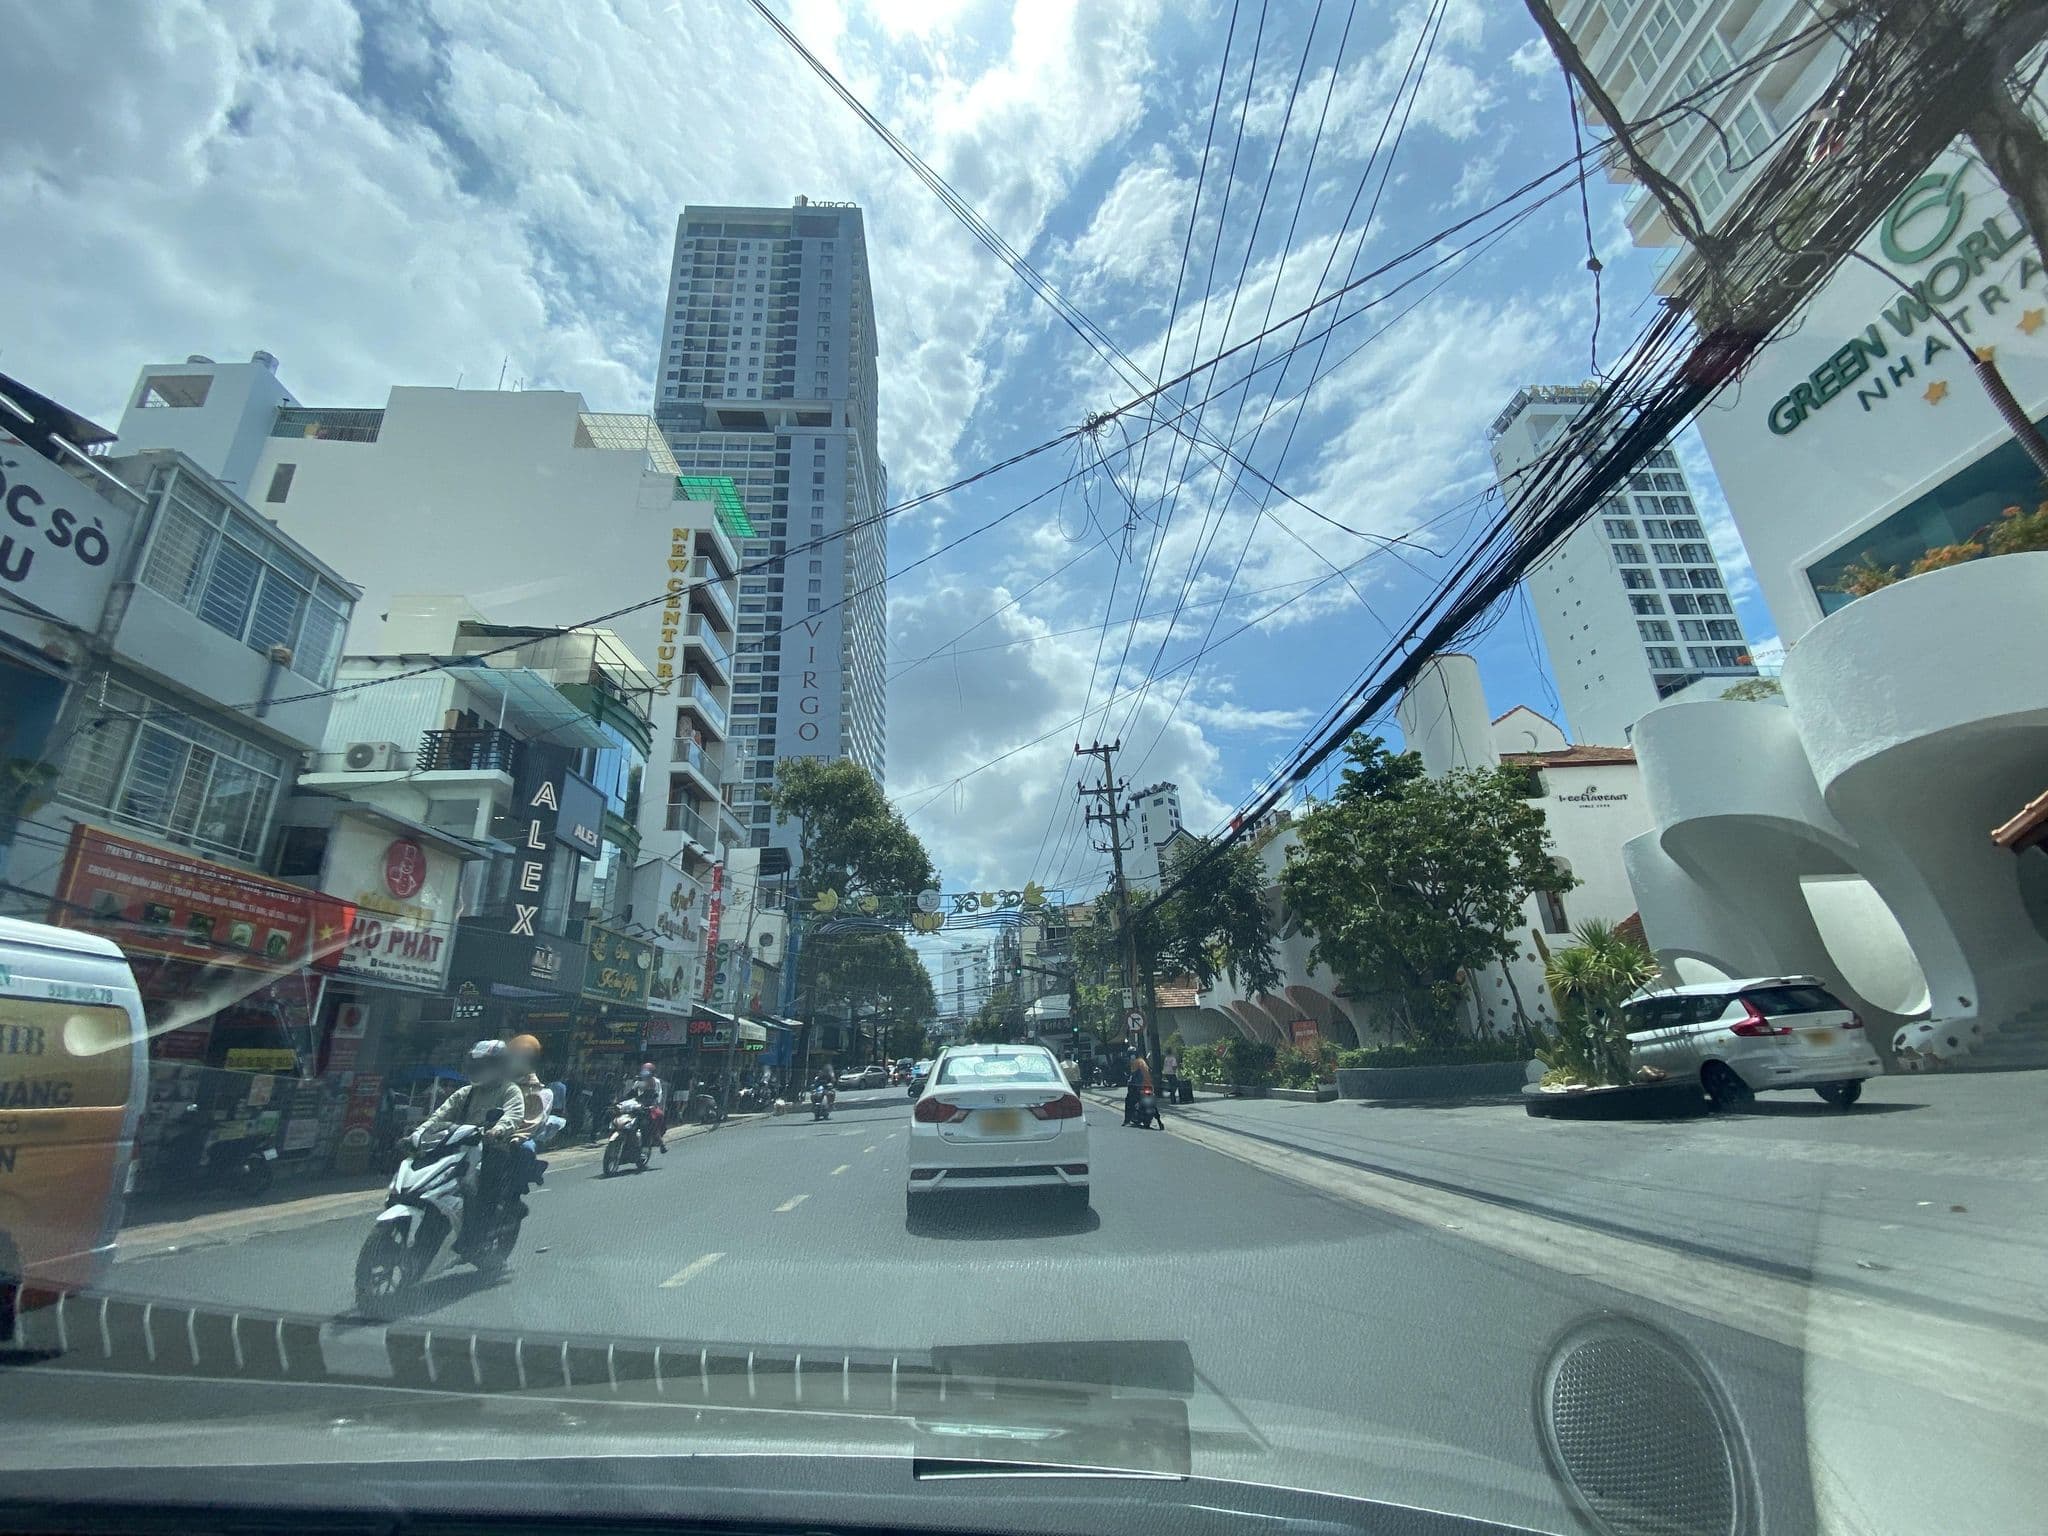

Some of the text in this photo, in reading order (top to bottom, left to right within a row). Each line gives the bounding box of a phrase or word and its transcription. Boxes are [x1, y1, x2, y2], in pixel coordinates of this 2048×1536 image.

[1767, 217, 2032, 435] GREEN WORL
[1857, 256, 2046, 411] NHA TRA
[44, 507, 109, 566] SÒ
[656, 527, 690, 696] NEW CENTURY
[798, 621, 823, 741] VIRGO
[510, 781, 558, 936] ALEX
[573, 823, 599, 848] ALEX
[387, 928, 443, 961] PHÁT
[689, 1021, 714, 1034] SPA
